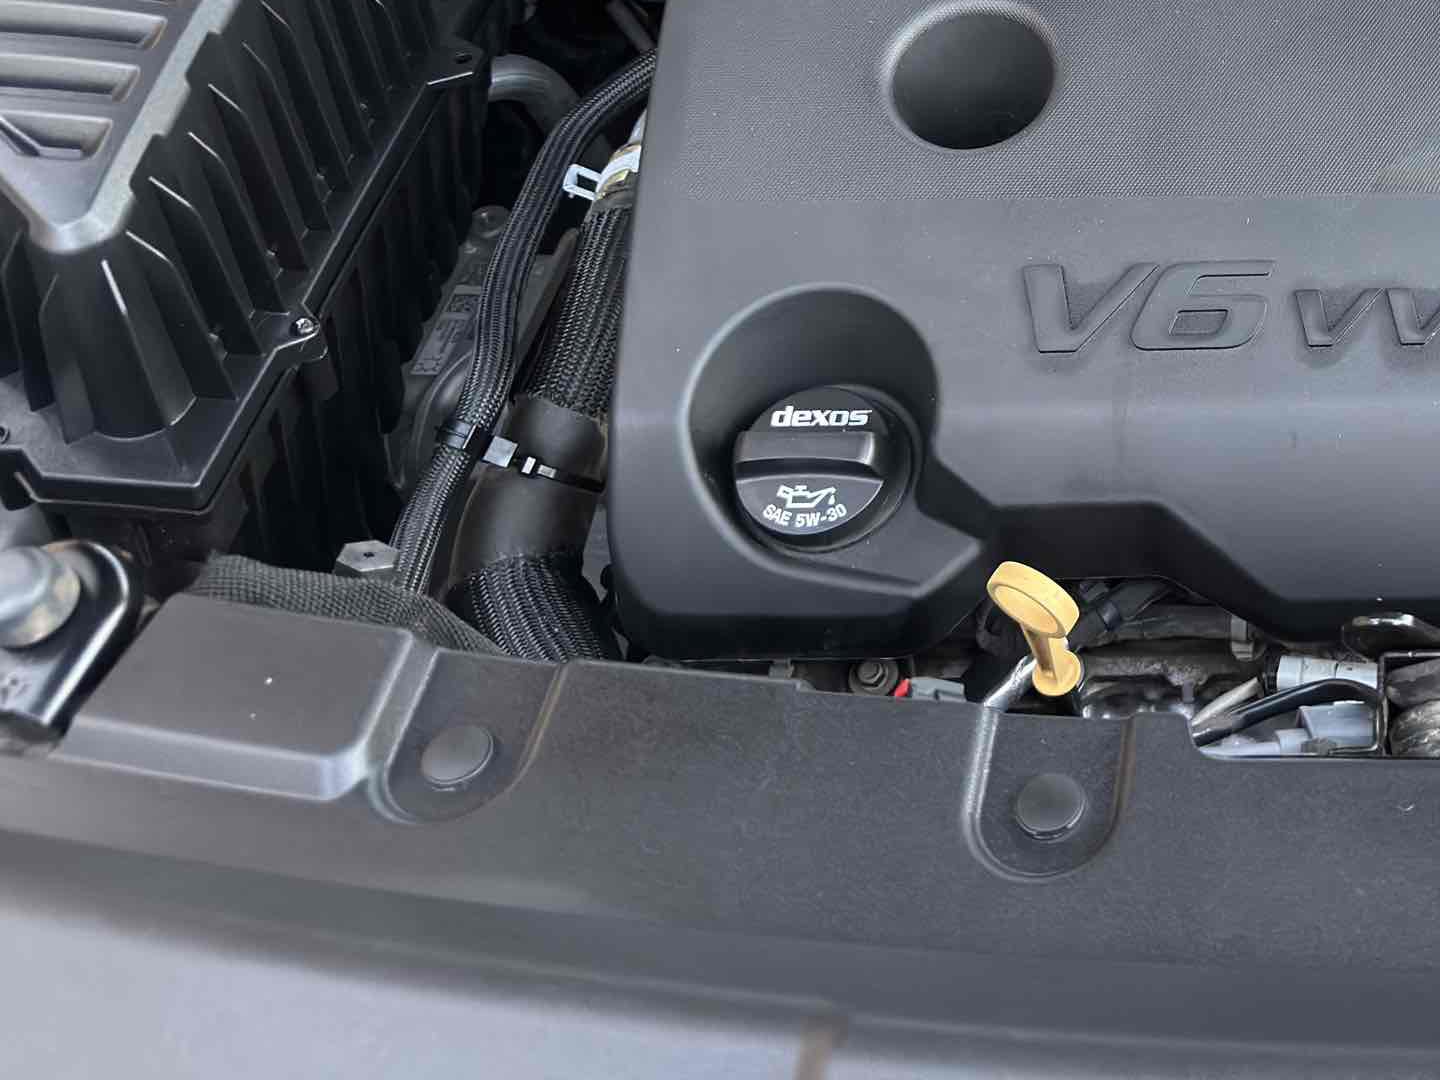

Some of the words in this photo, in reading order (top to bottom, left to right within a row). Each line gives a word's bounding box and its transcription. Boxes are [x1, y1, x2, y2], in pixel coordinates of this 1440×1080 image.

[1022, 259, 1277, 354] V6
[769, 404, 873, 428] dexos
[762, 503, 793, 526] SAE
[795, 502, 848, 528] 5W-30
